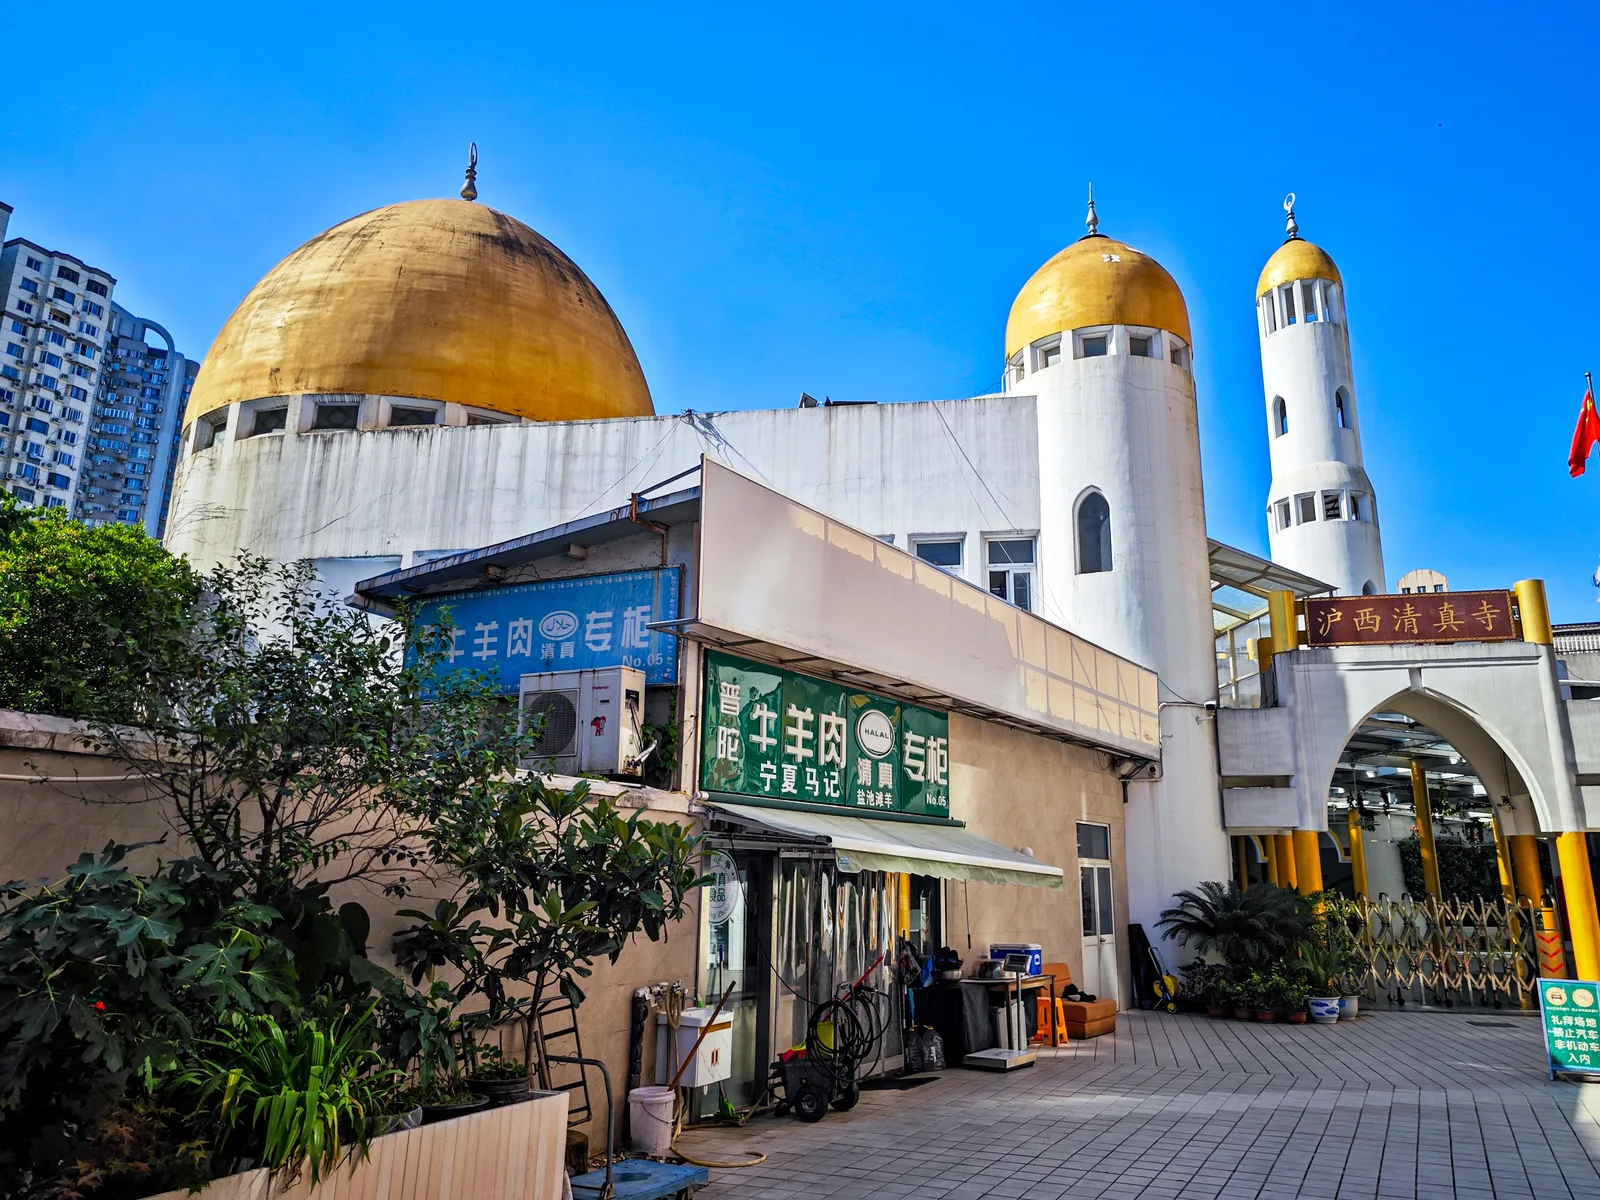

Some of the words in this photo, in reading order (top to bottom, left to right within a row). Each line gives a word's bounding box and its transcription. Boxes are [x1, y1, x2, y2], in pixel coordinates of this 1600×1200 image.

[546, 619, 573, 632] حلال
[1317, 600, 1501, 637] 沪西清真寺
[585, 605, 651, 653] 专柜
[540, 641, 575, 660] 清真
[622, 653, 663, 668] No.05
[716, 681, 741, 763] 普陀
[864, 728, 890, 739] HALAL
[749, 703, 847, 769] 牛羊肉
[903, 730, 948, 785] 专柜
[759, 761, 840, 798] 宁夏马记
[856, 757, 893, 789] 清真
[856, 789, 893, 808] 盐池滩羊
[926, 793, 947, 807] No.05
[1551, 1015, 1597, 1028] 礼拜场地
[1552, 1027, 1599, 1040] 禁止汽车
[1554, 1039, 1600, 1052] 非机动车
[1568, 1052, 1591, 1065] 入内
